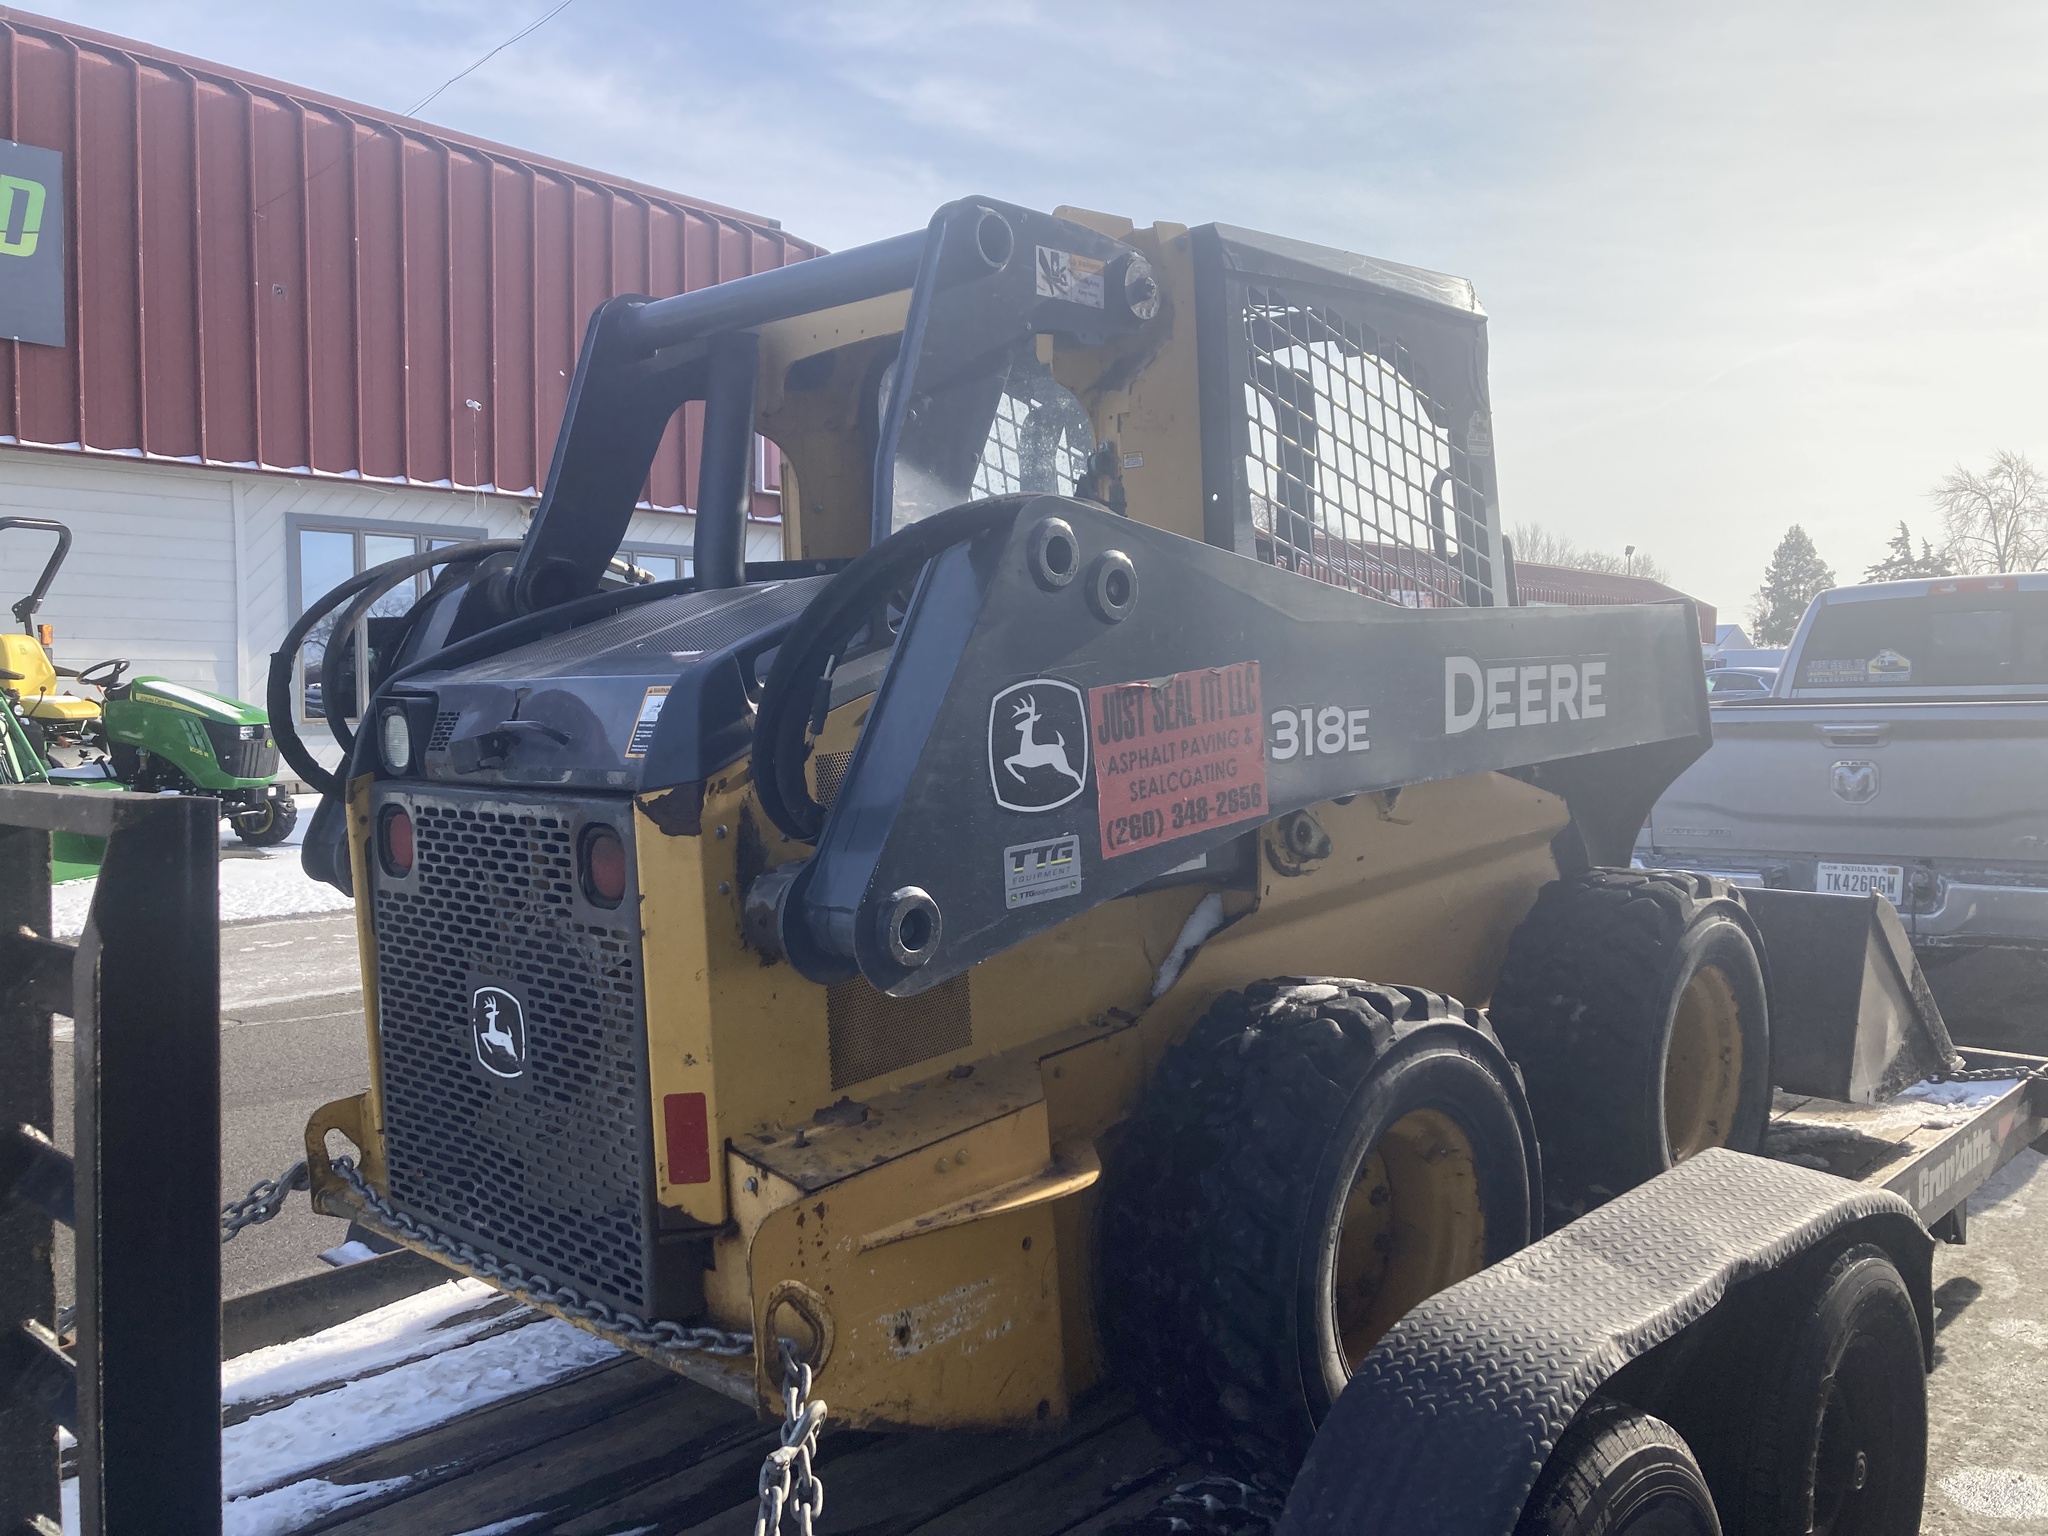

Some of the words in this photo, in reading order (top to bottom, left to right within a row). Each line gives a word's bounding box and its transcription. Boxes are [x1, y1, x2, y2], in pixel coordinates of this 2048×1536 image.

[1098, 688, 1145, 745] JUST
[1152, 678, 1196, 734] SEAL
[1201, 674, 1223, 724] IT!
[1227, 667, 1257, 718] LLC
[1445, 656, 1606, 734] DEERE
[1108, 742, 1176, 776] ASPHALT
[1181, 729, 1239, 760] PAVING
[1244, 727, 1253, 745] &
[1271, 705, 1370, 760] 318E
[1129, 758, 1238, 802] SEALCOATING
[1106, 809, 1164, 850] (260)
[1171, 783, 1262, 830] 348-2656
[1009, 841, 1074, 872] TTG
[1012, 867, 1071, 885] EQUIPMENT
[1841, 865, 1879, 873] INDIANA
